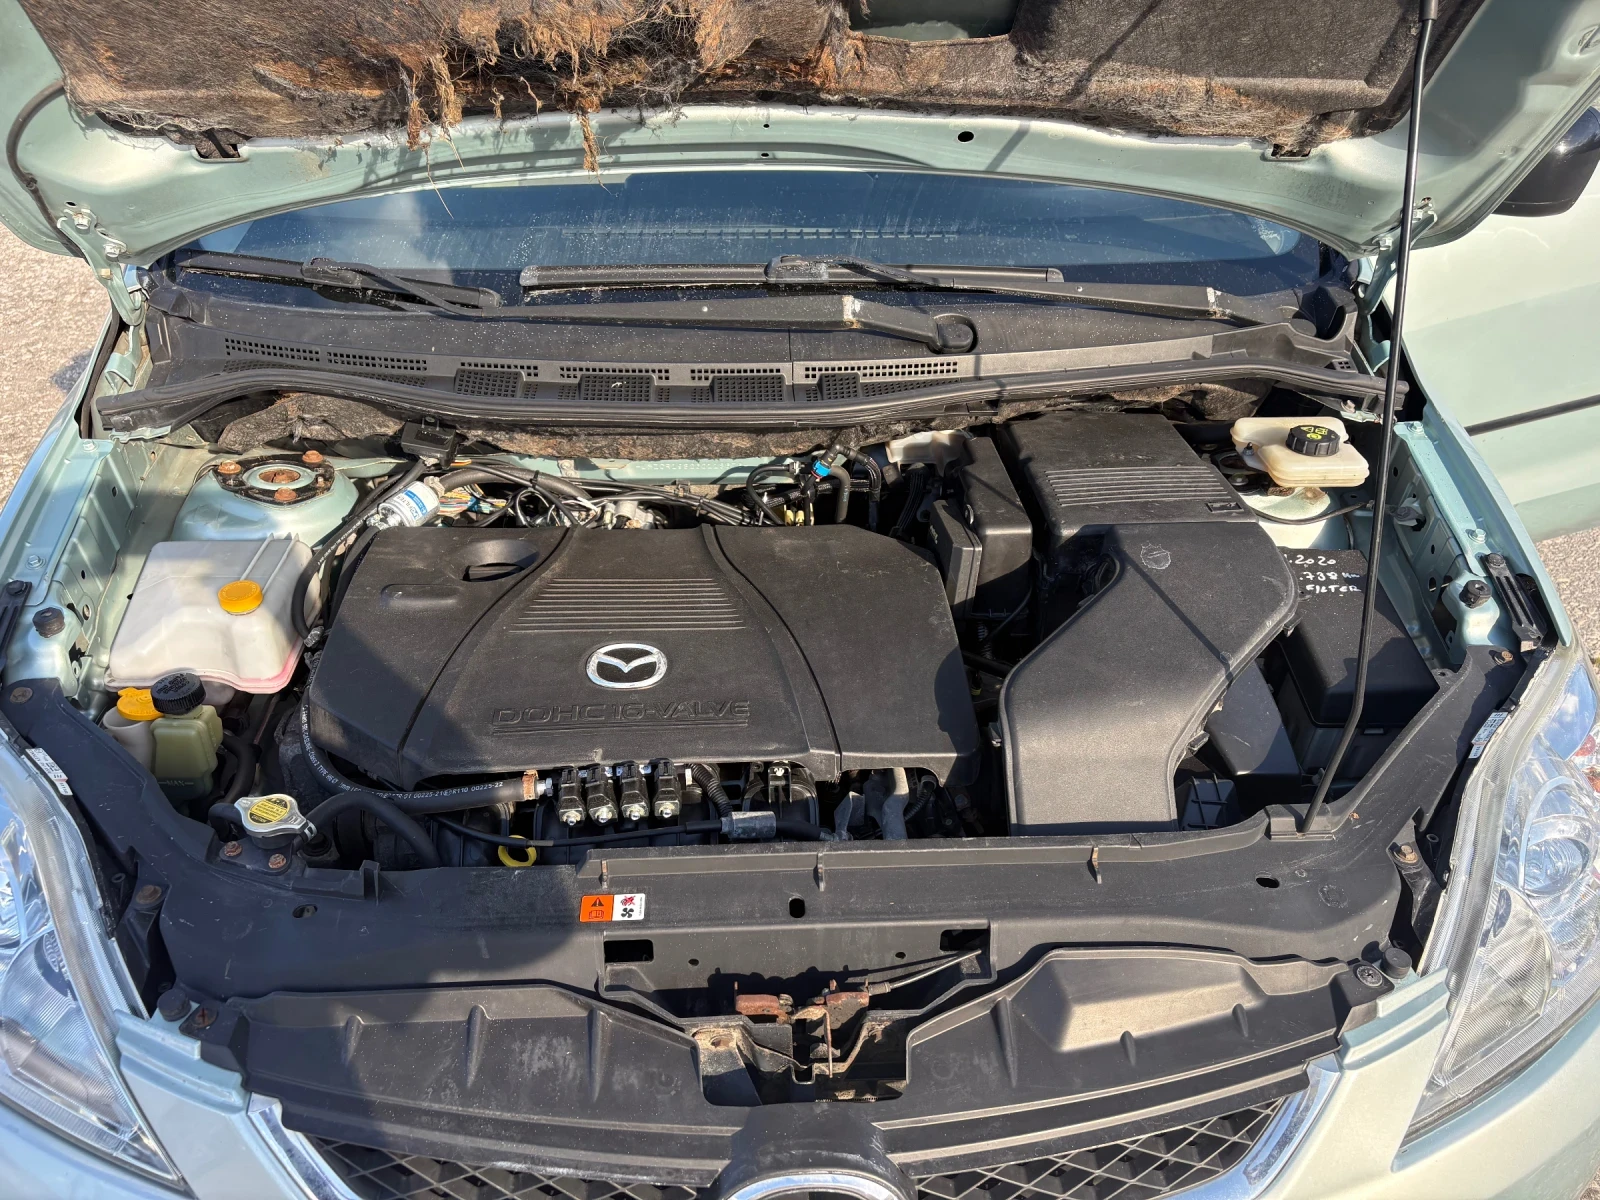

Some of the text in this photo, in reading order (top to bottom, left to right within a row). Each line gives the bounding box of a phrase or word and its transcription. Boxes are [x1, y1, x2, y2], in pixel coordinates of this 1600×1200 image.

[1284, 554, 1337, 566] .2020
[492, 700, 751, 725] DOHC 16-VALVE
